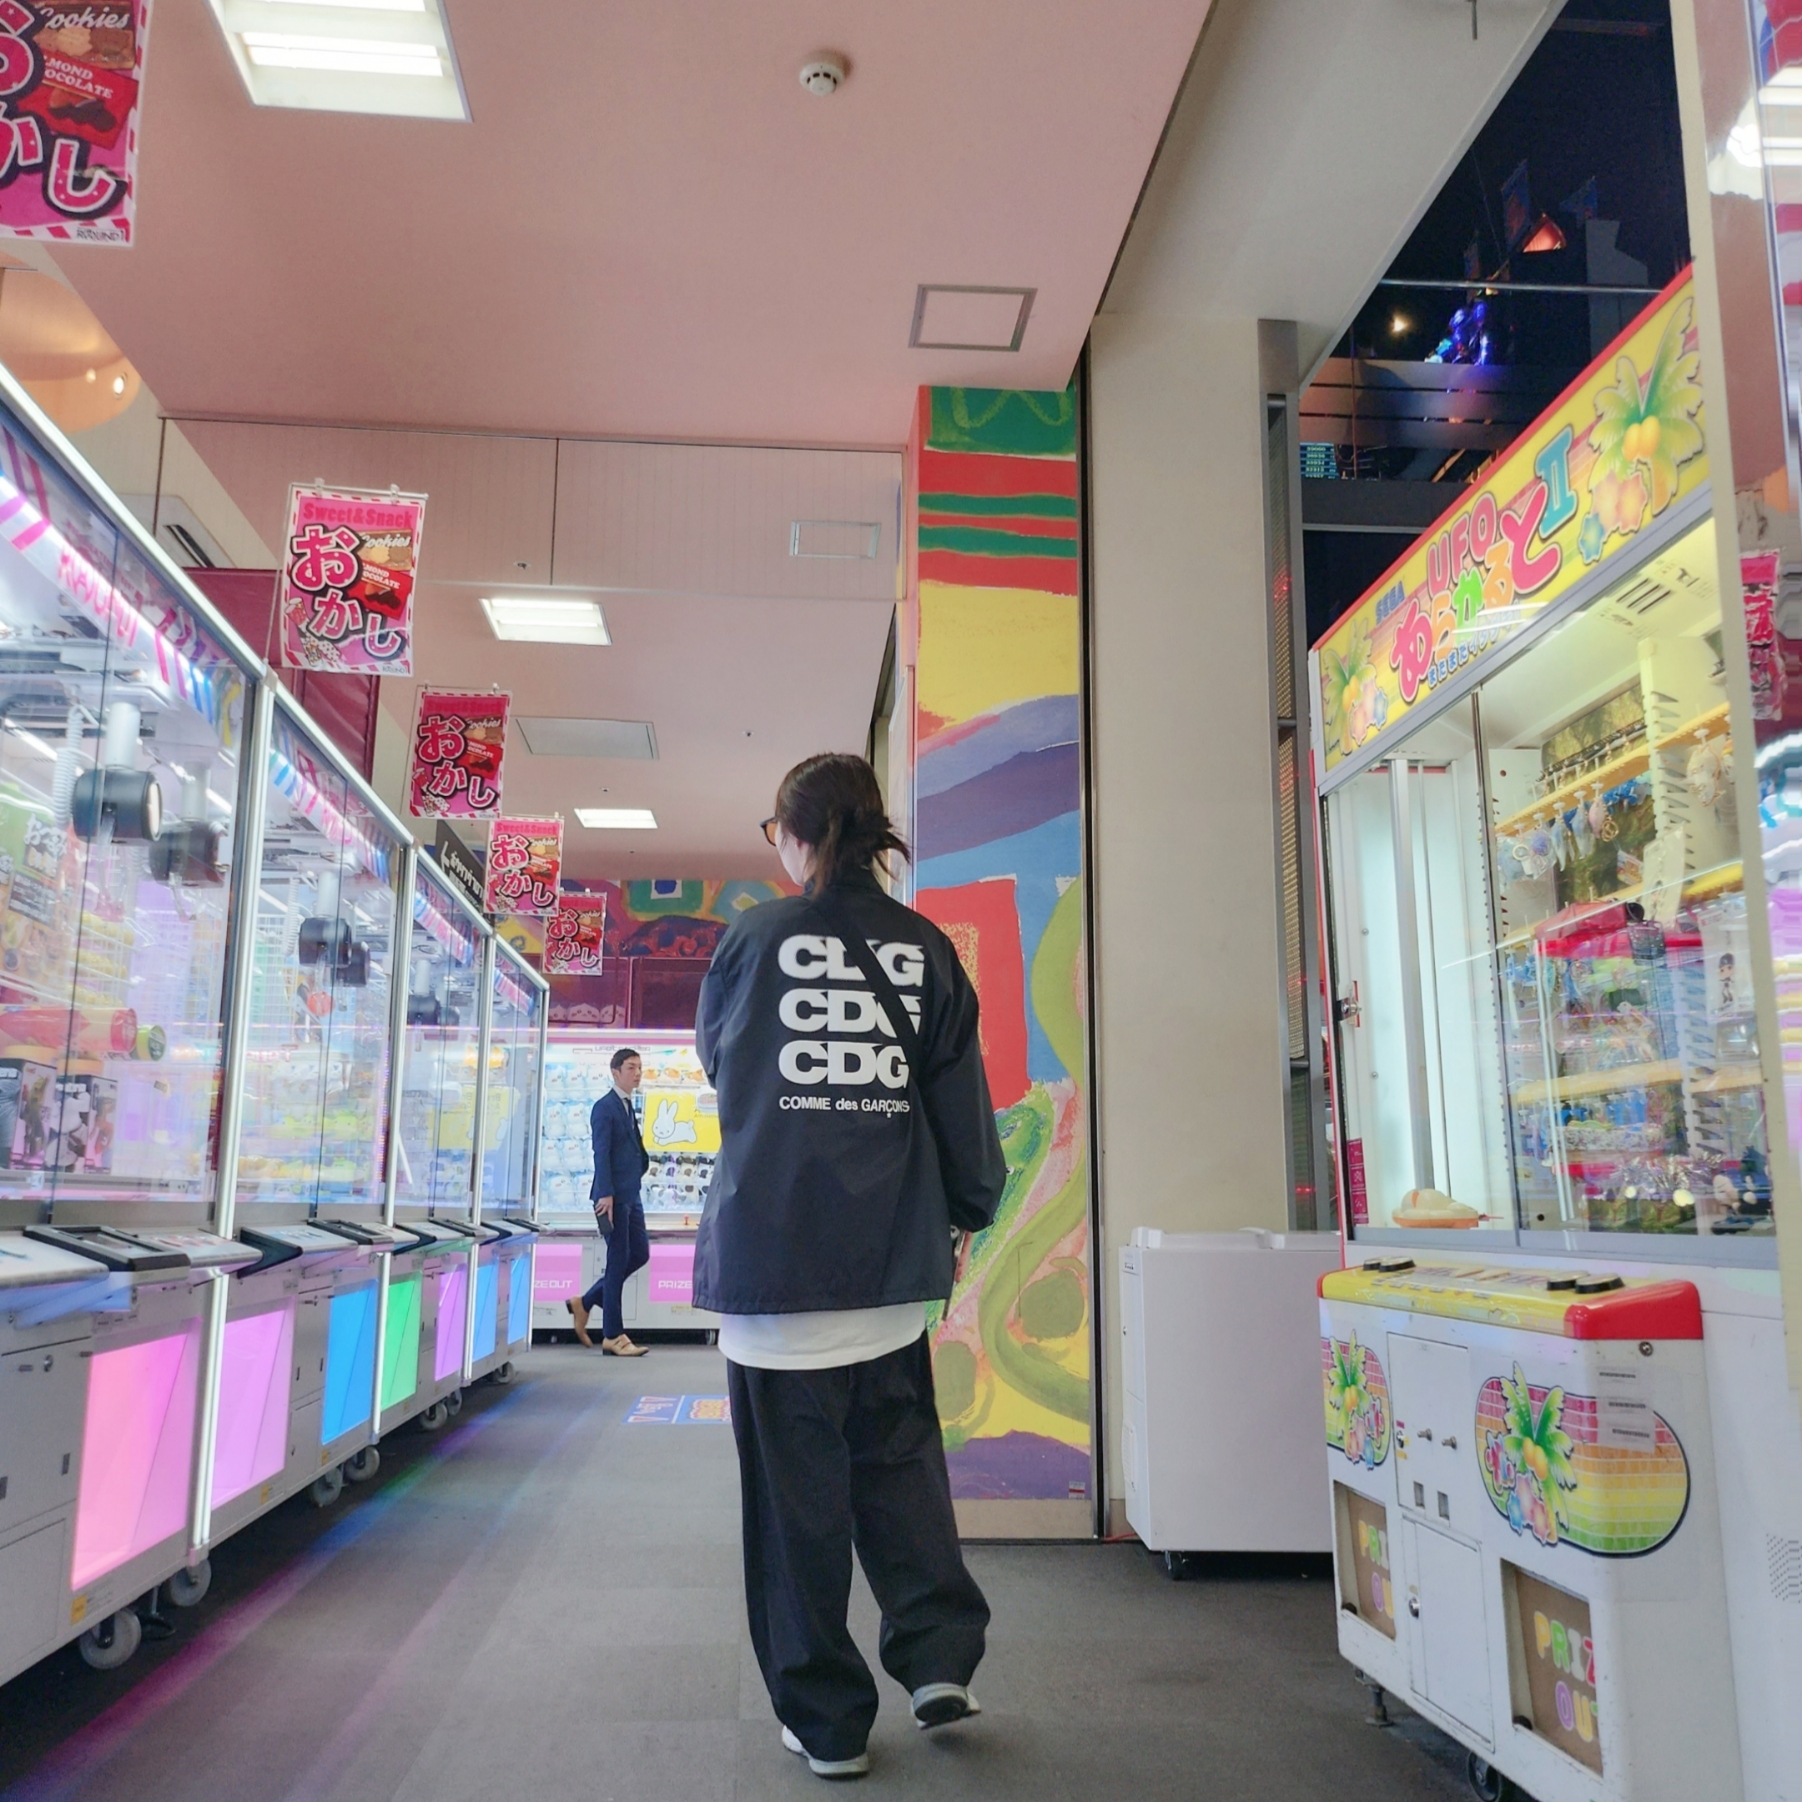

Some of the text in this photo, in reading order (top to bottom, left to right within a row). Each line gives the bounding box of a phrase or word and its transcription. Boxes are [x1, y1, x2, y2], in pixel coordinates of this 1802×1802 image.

[1426, 492, 1497, 600] UFO
[778, 1040, 910, 1089] CDG
[779, 1096, 831, 1111] COMME
[835, 1097, 859, 1111] des
[1534, 1611, 1597, 1689] PRIZ
[1555, 1680, 1600, 1742] OU
